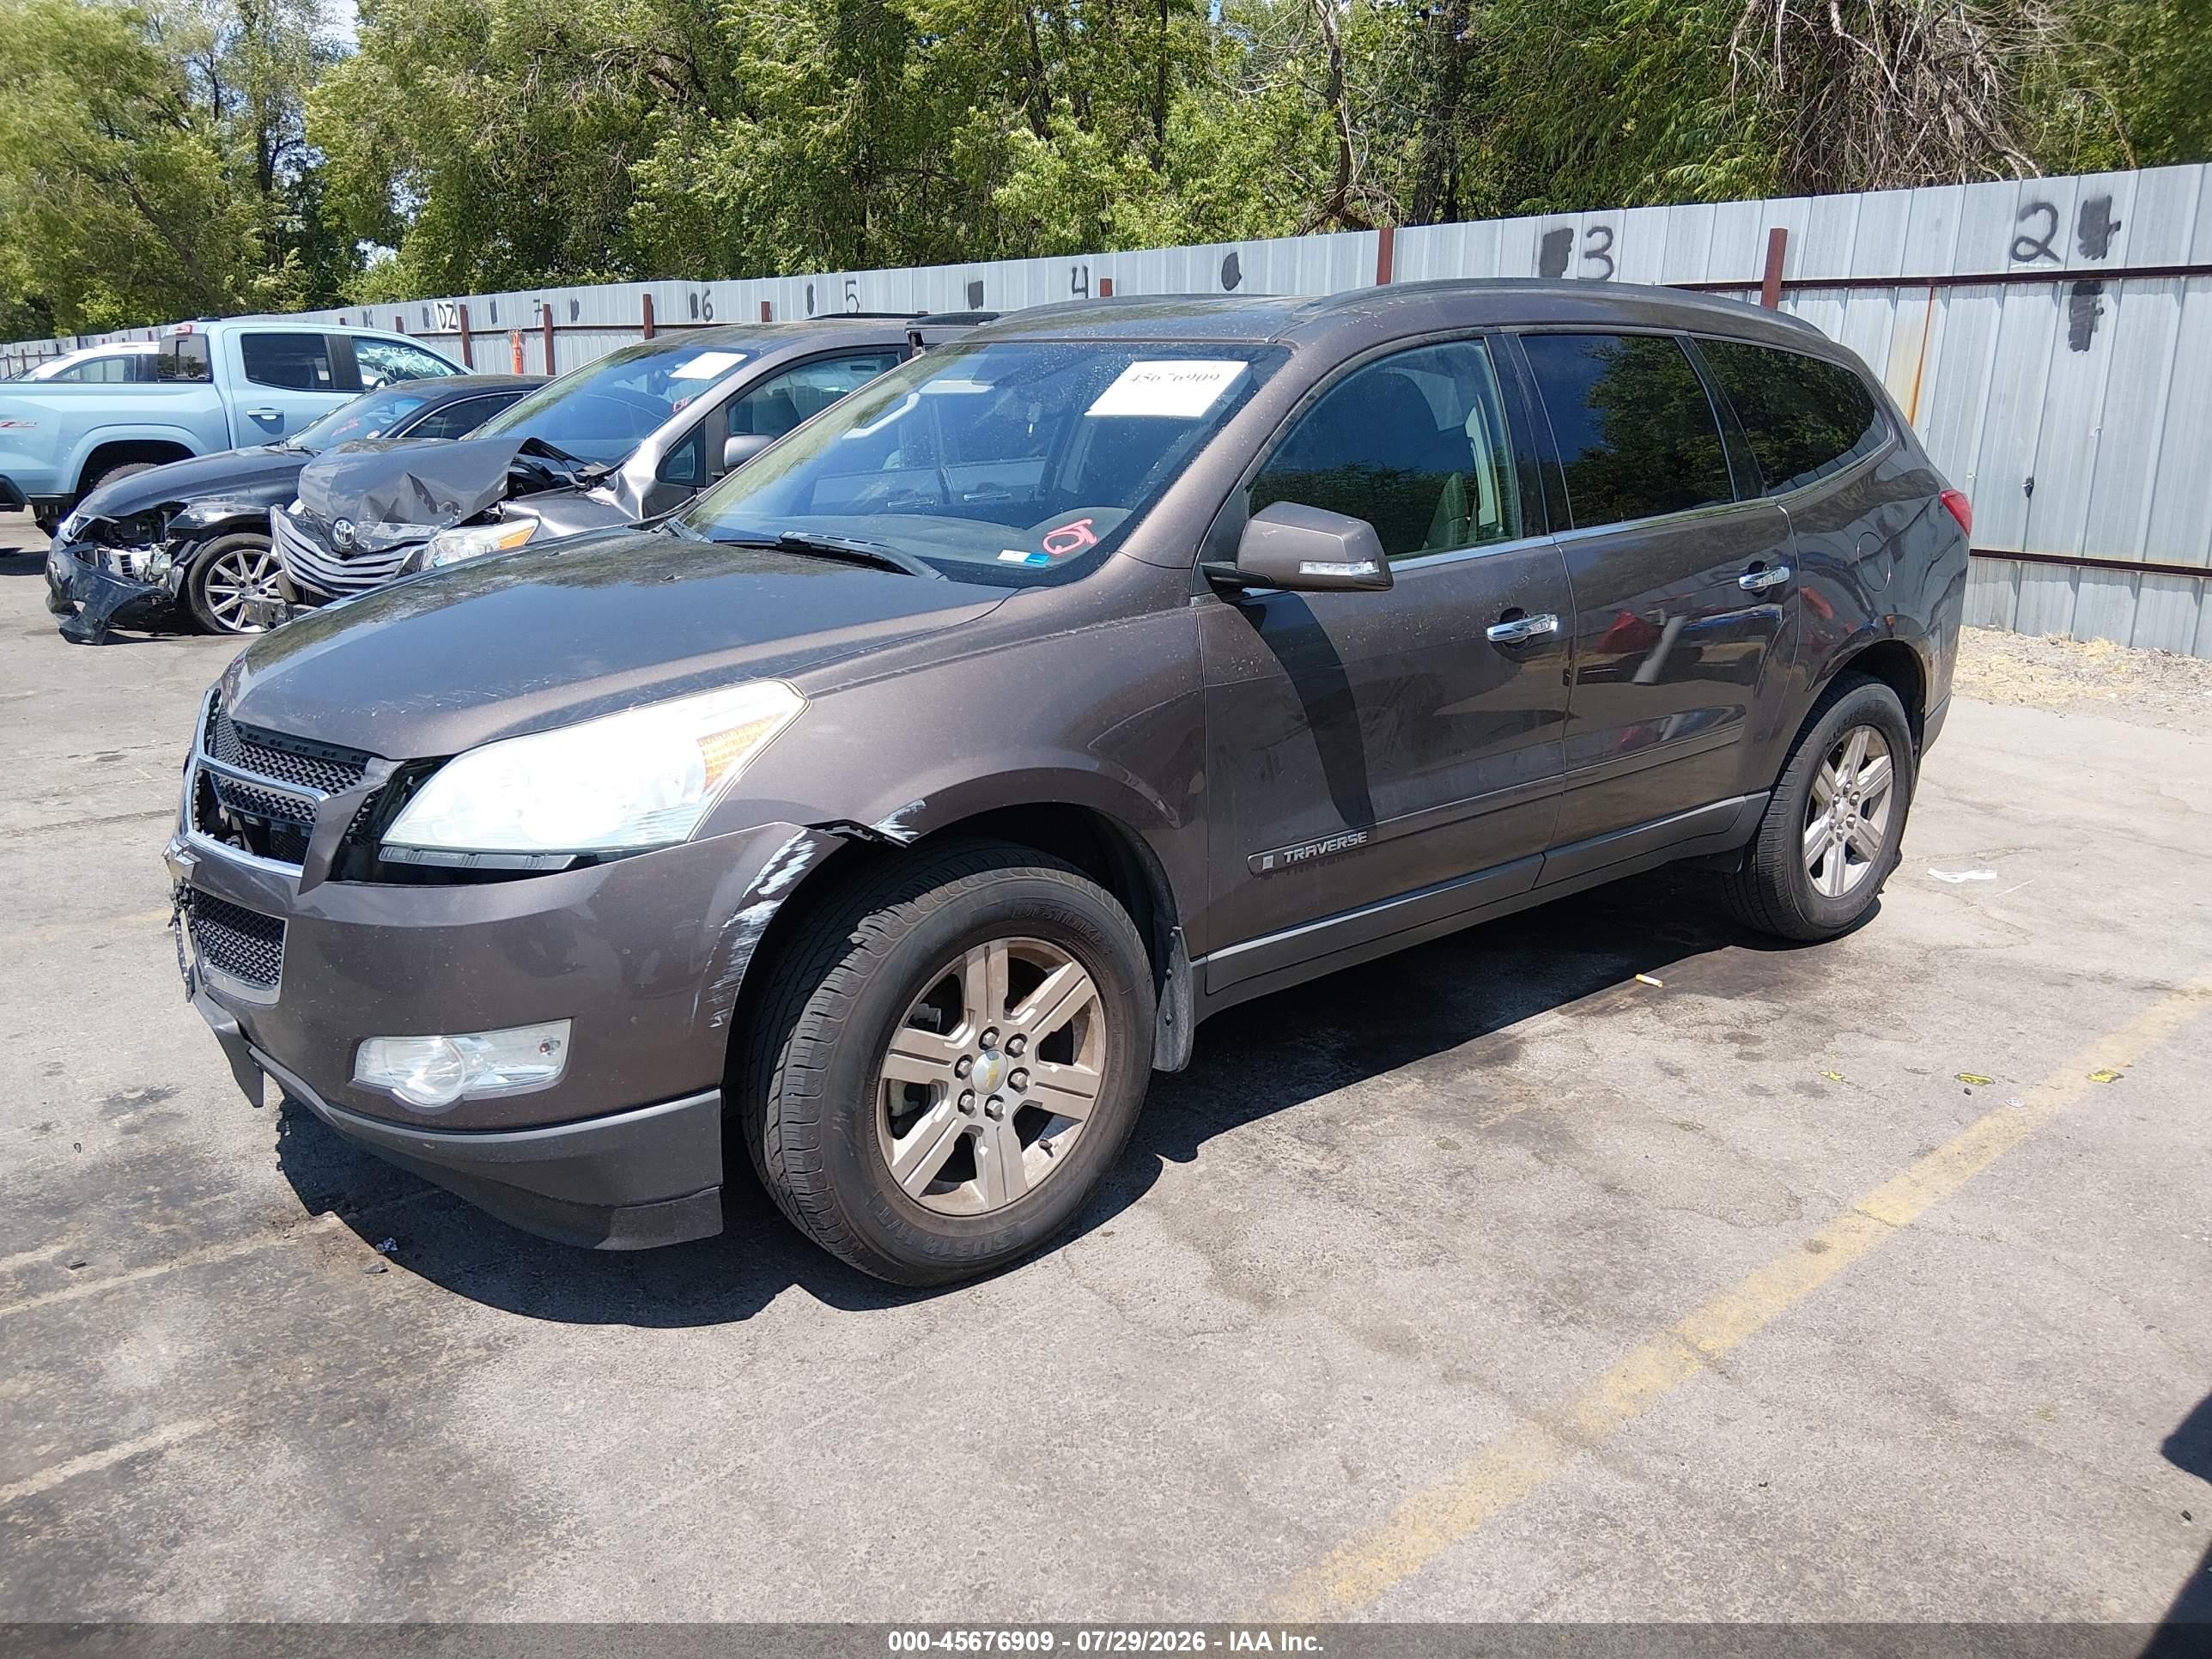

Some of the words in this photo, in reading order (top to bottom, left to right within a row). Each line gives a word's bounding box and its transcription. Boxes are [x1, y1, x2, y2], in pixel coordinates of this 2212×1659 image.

[2011, 202, 2062, 263] 2
[1577, 226, 1614, 280] 3
[845, 280, 860, 313] 5
[1072, 265, 1089, 299] 4
[533, 299, 543, 328] 7
[702, 289, 714, 322] 6
[1284, 831, 1368, 863] TRAVERSE
